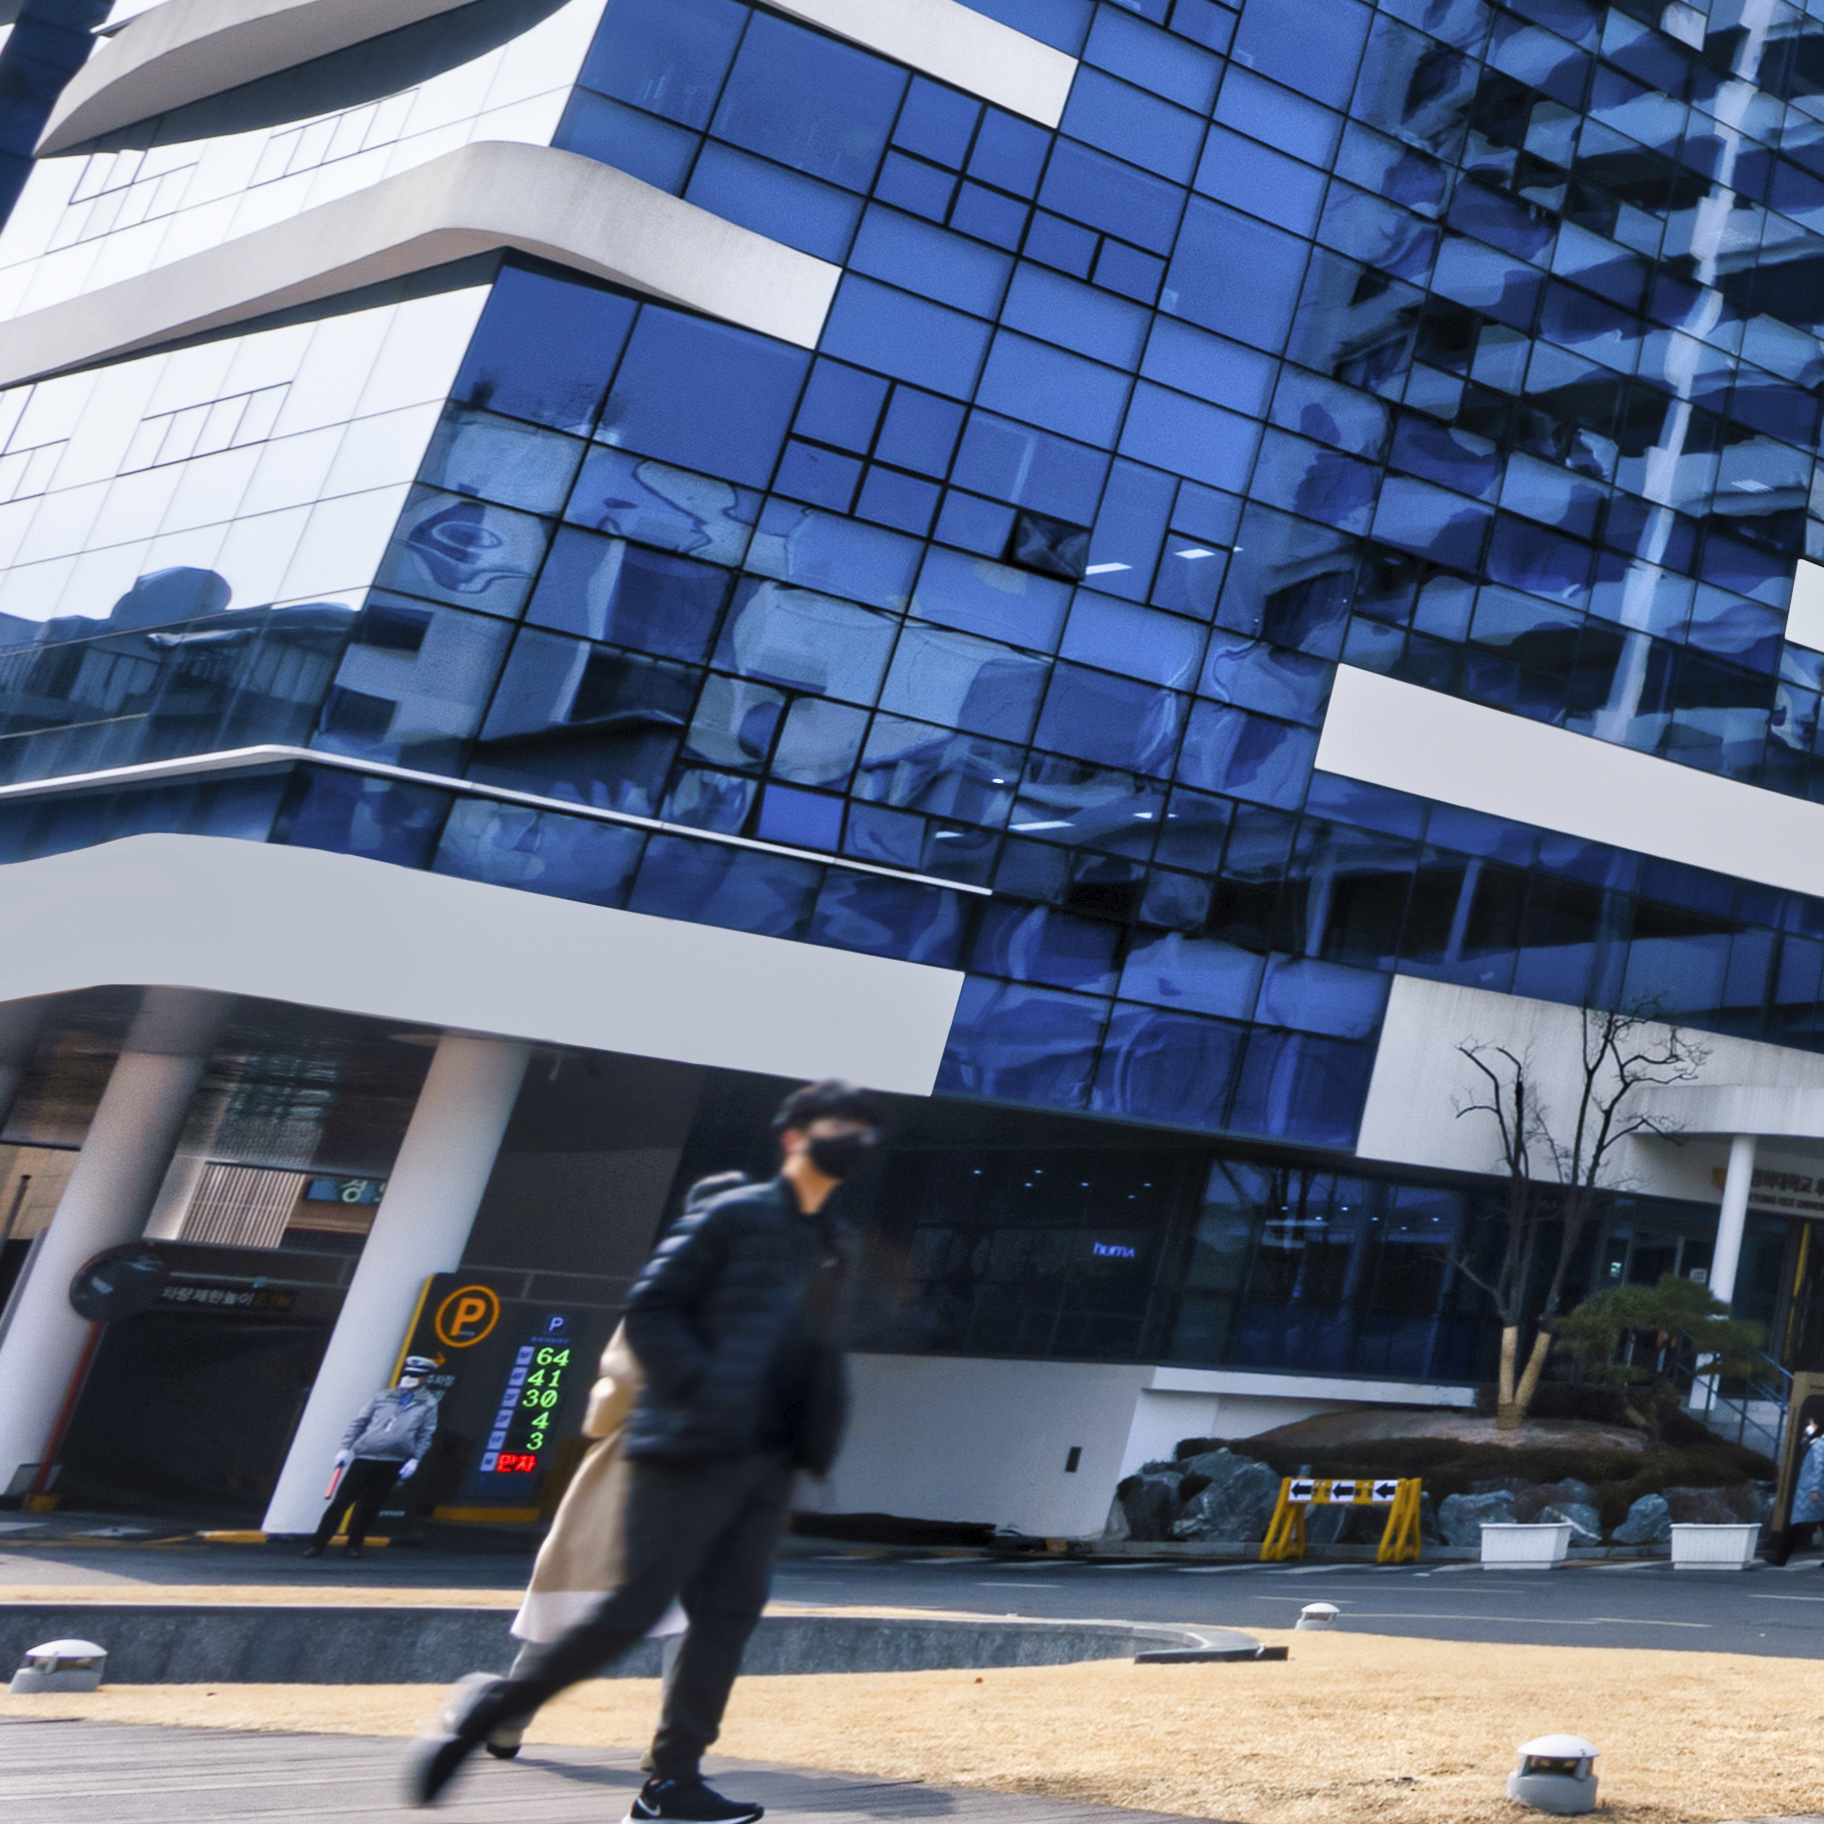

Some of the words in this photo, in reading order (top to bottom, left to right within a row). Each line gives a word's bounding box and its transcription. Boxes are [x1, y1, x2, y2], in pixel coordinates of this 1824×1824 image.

[450, 1297, 487, 1336] P
[548, 1317, 564, 1332] P
[536, 1347, 570, 1367] 64
[527, 1369, 561, 1387] 41
[522, 1389, 558, 1408] 30
[531, 1411, 549, 1429] 4
[526, 1432, 544, 1451] 3
[496, 1452, 537, 1473] 만차
